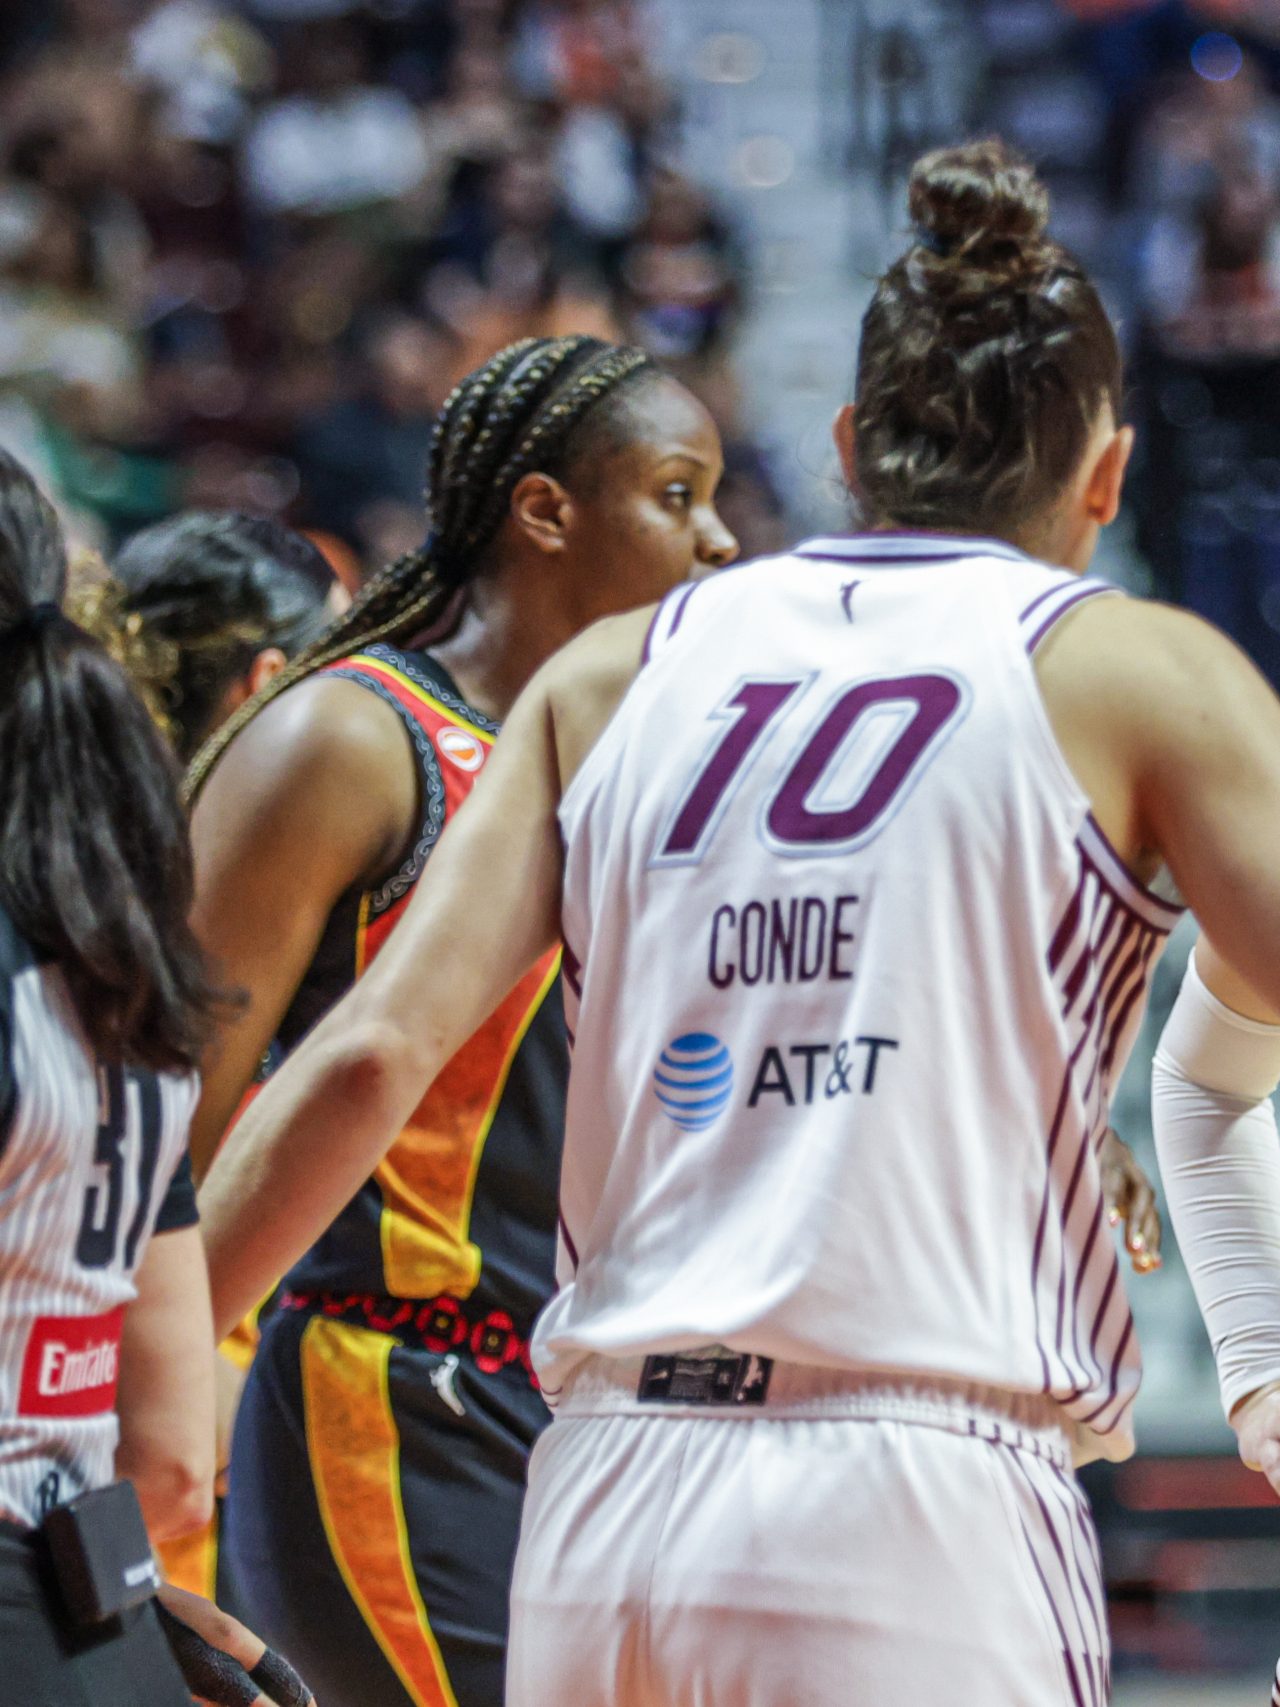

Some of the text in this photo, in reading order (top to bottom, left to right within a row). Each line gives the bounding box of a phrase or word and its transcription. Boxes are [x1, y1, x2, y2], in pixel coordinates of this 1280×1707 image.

[650, 669, 971, 867] 10
[708, 895, 859, 989] CONDE
[747, 1036, 899, 1108] AT&T
[40, 1340, 118, 1395] Emirate
